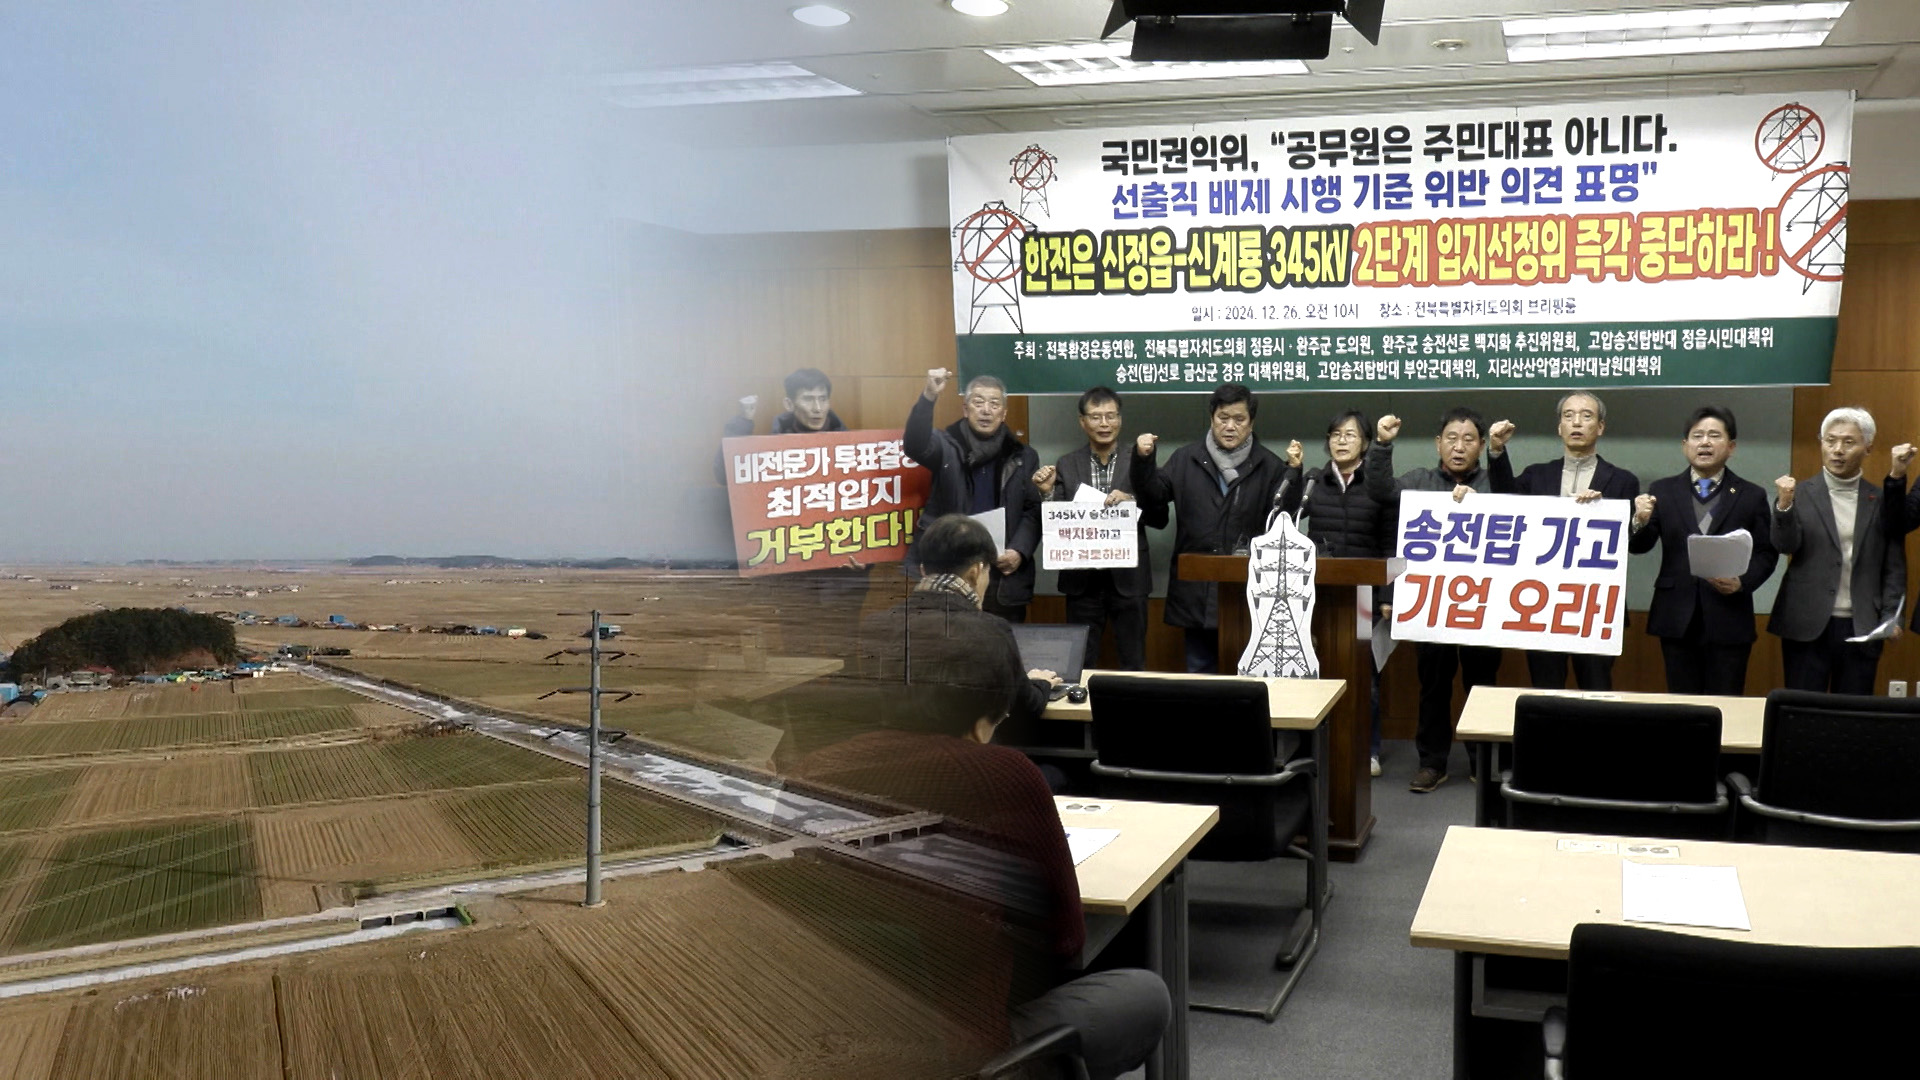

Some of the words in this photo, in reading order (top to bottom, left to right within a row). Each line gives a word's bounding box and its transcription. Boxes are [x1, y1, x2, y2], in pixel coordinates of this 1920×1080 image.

[1101, 134, 1259, 175] 국민권익위,
[1423, 118, 1553, 162] 주민대표
[1564, 112, 1678, 156] 아니다.
[1112, 181, 1198, 219] 선출직
[1208, 178, 1270, 216] 배제
[1281, 175, 1342, 213] 시행
[1352, 172, 1414, 210] 기준
[1424, 168, 1490, 208] 위반
[1500, 166, 1563, 205] 의견
[1023, 232, 1096, 293] 한전은
[1102, 228, 1264, 291] 신정읍-신계룡
[1270, 228, 1350, 286] 345kV
[1356, 223, 1429, 284] 2단계
[1436, 219, 1566, 281] 입지선정위
[1575, 217, 1632, 277] 즉각
[1191, 306, 1214, 322] 일시
[1224, 305, 1257, 320] 2024.
[1262, 305, 1279, 320] 12.
[1283, 304, 1301, 320] 26.
[1305, 303, 1328, 320] 오전
[1333, 303, 1359, 319] 10시
[1379, 301, 1402, 319] 장소
[1414, 299, 1523, 318] 전북특별자치도의회
[1527, 297, 1577, 316] 브리핑룸
[1045, 338, 1138, 361] 전북환경운동연합,
[1144, 335, 1247, 359] 전북특별자치도의회
[1250, 335, 1285, 358] 정읍시
[1296, 334, 1332, 357] 완주군
[1335, 333, 1375, 357] 도의원,
[1382, 333, 1418, 355] 완주군
[1421, 332, 1471, 355] 송전선로
[1474, 331, 1511, 354] 백지화
[1514, 330, 1580, 353] 추진위원회,
[1587, 327, 1678, 352] 고압송전탑반대
[1681, 325, 1774, 351] 정읍시민대책위
[1115, 362, 1181, 385] 송전(탑)선로
[1184, 362, 1218, 384] 금산군
[1222, 361, 1245, 383] 경유
[1248, 360, 1310, 383] 대책위원회,
[1317, 358, 1400, 382] 고압송전탑반대
[1403, 357, 1480, 381] 부안군대책위,
[1487, 355, 1662, 380] 지리산산악열차반대남원대책위
[734, 447, 831, 485] 비전문가
[766, 475, 902, 518] 최적입지
[1048, 510, 1086, 520] 345kV
[1058, 527, 1121, 541] 백지화하고
[1403, 508, 1527, 566] 송전탑
[1535, 516, 1624, 570] 가고
[1049, 549, 1074, 562] 대안
[1078, 548, 1131, 561] 검토하라!
[1396, 574, 1492, 630] 기업
[1501, 578, 1620, 640] 오라!
